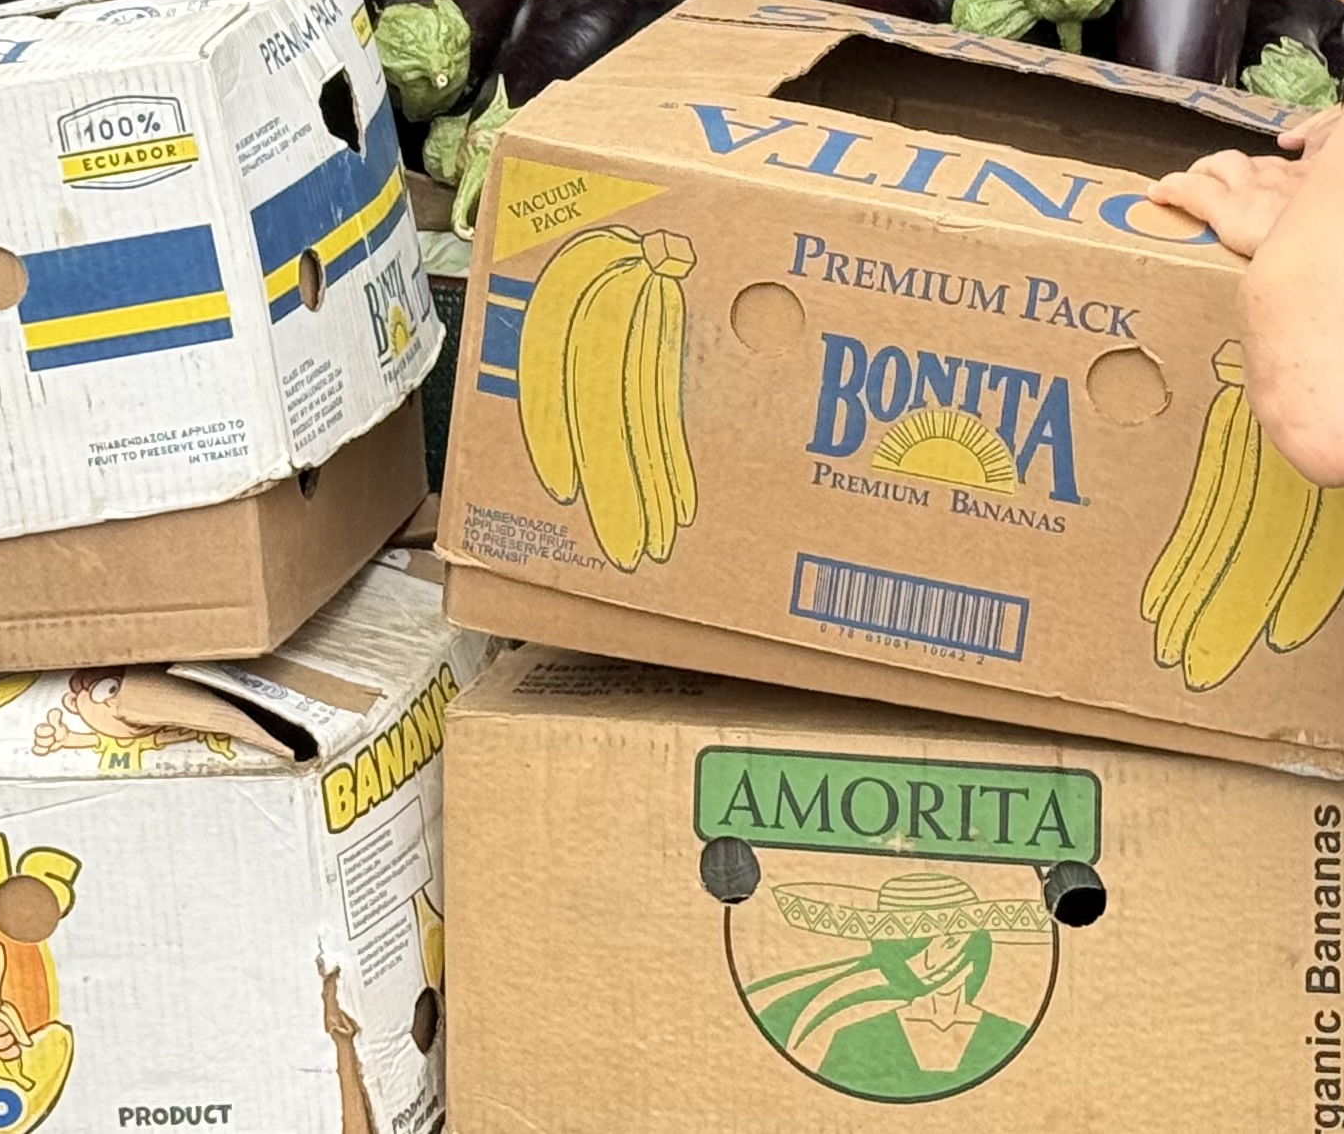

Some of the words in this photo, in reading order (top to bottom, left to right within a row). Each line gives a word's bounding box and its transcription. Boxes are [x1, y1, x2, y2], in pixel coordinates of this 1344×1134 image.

[82, 109, 161, 144] 100%
[80, 141, 180, 174] ECUADOR
[683, 101, 1222, 250] ONITA
[507, 175, 590, 224] VACUUM
[529, 198, 584, 237] PACK
[790, 231, 1008, 316] PREMIUM
[1022, 275, 1140, 341] PACK
[89, 429, 177, 454] THIABENDAZOLE
[180, 421, 227, 439] APPLIED
[228, 419, 245, 431] TO
[805, 331, 1083, 507] BONITA
[87, 453, 119, 468] FRUIT
[121, 451, 138, 463] TO
[140, 441, 195, 460] PRESERVE
[197, 432, 247, 450] QUALITY
[188, 454, 201, 465] IN
[202, 445, 250, 462] TRANSIT
[811, 461, 931, 508] PREMIUM
[949, 489, 1068, 535] BANANAS
[464, 516, 517, 538] APPLIED
[519, 528, 537, 542] TO
[539, 532, 578, 552] FRUIT
[465, 502, 569, 538] THIABENDAZOLE
[462, 539, 474, 553] IN
[476, 543, 530, 566] TRANSIT
[463, 526, 481, 542] TO
[482, 532, 550, 559] PRESERVE
[552, 550, 607, 572] QUALITY
[922, 643, 966, 663] 10042
[975, 654, 987, 666] 2
[716, 767, 1077, 850] AMORITA
[1305, 804, 1343, 996] Bananas
[118, 1102, 234, 1128] PRODUCT
